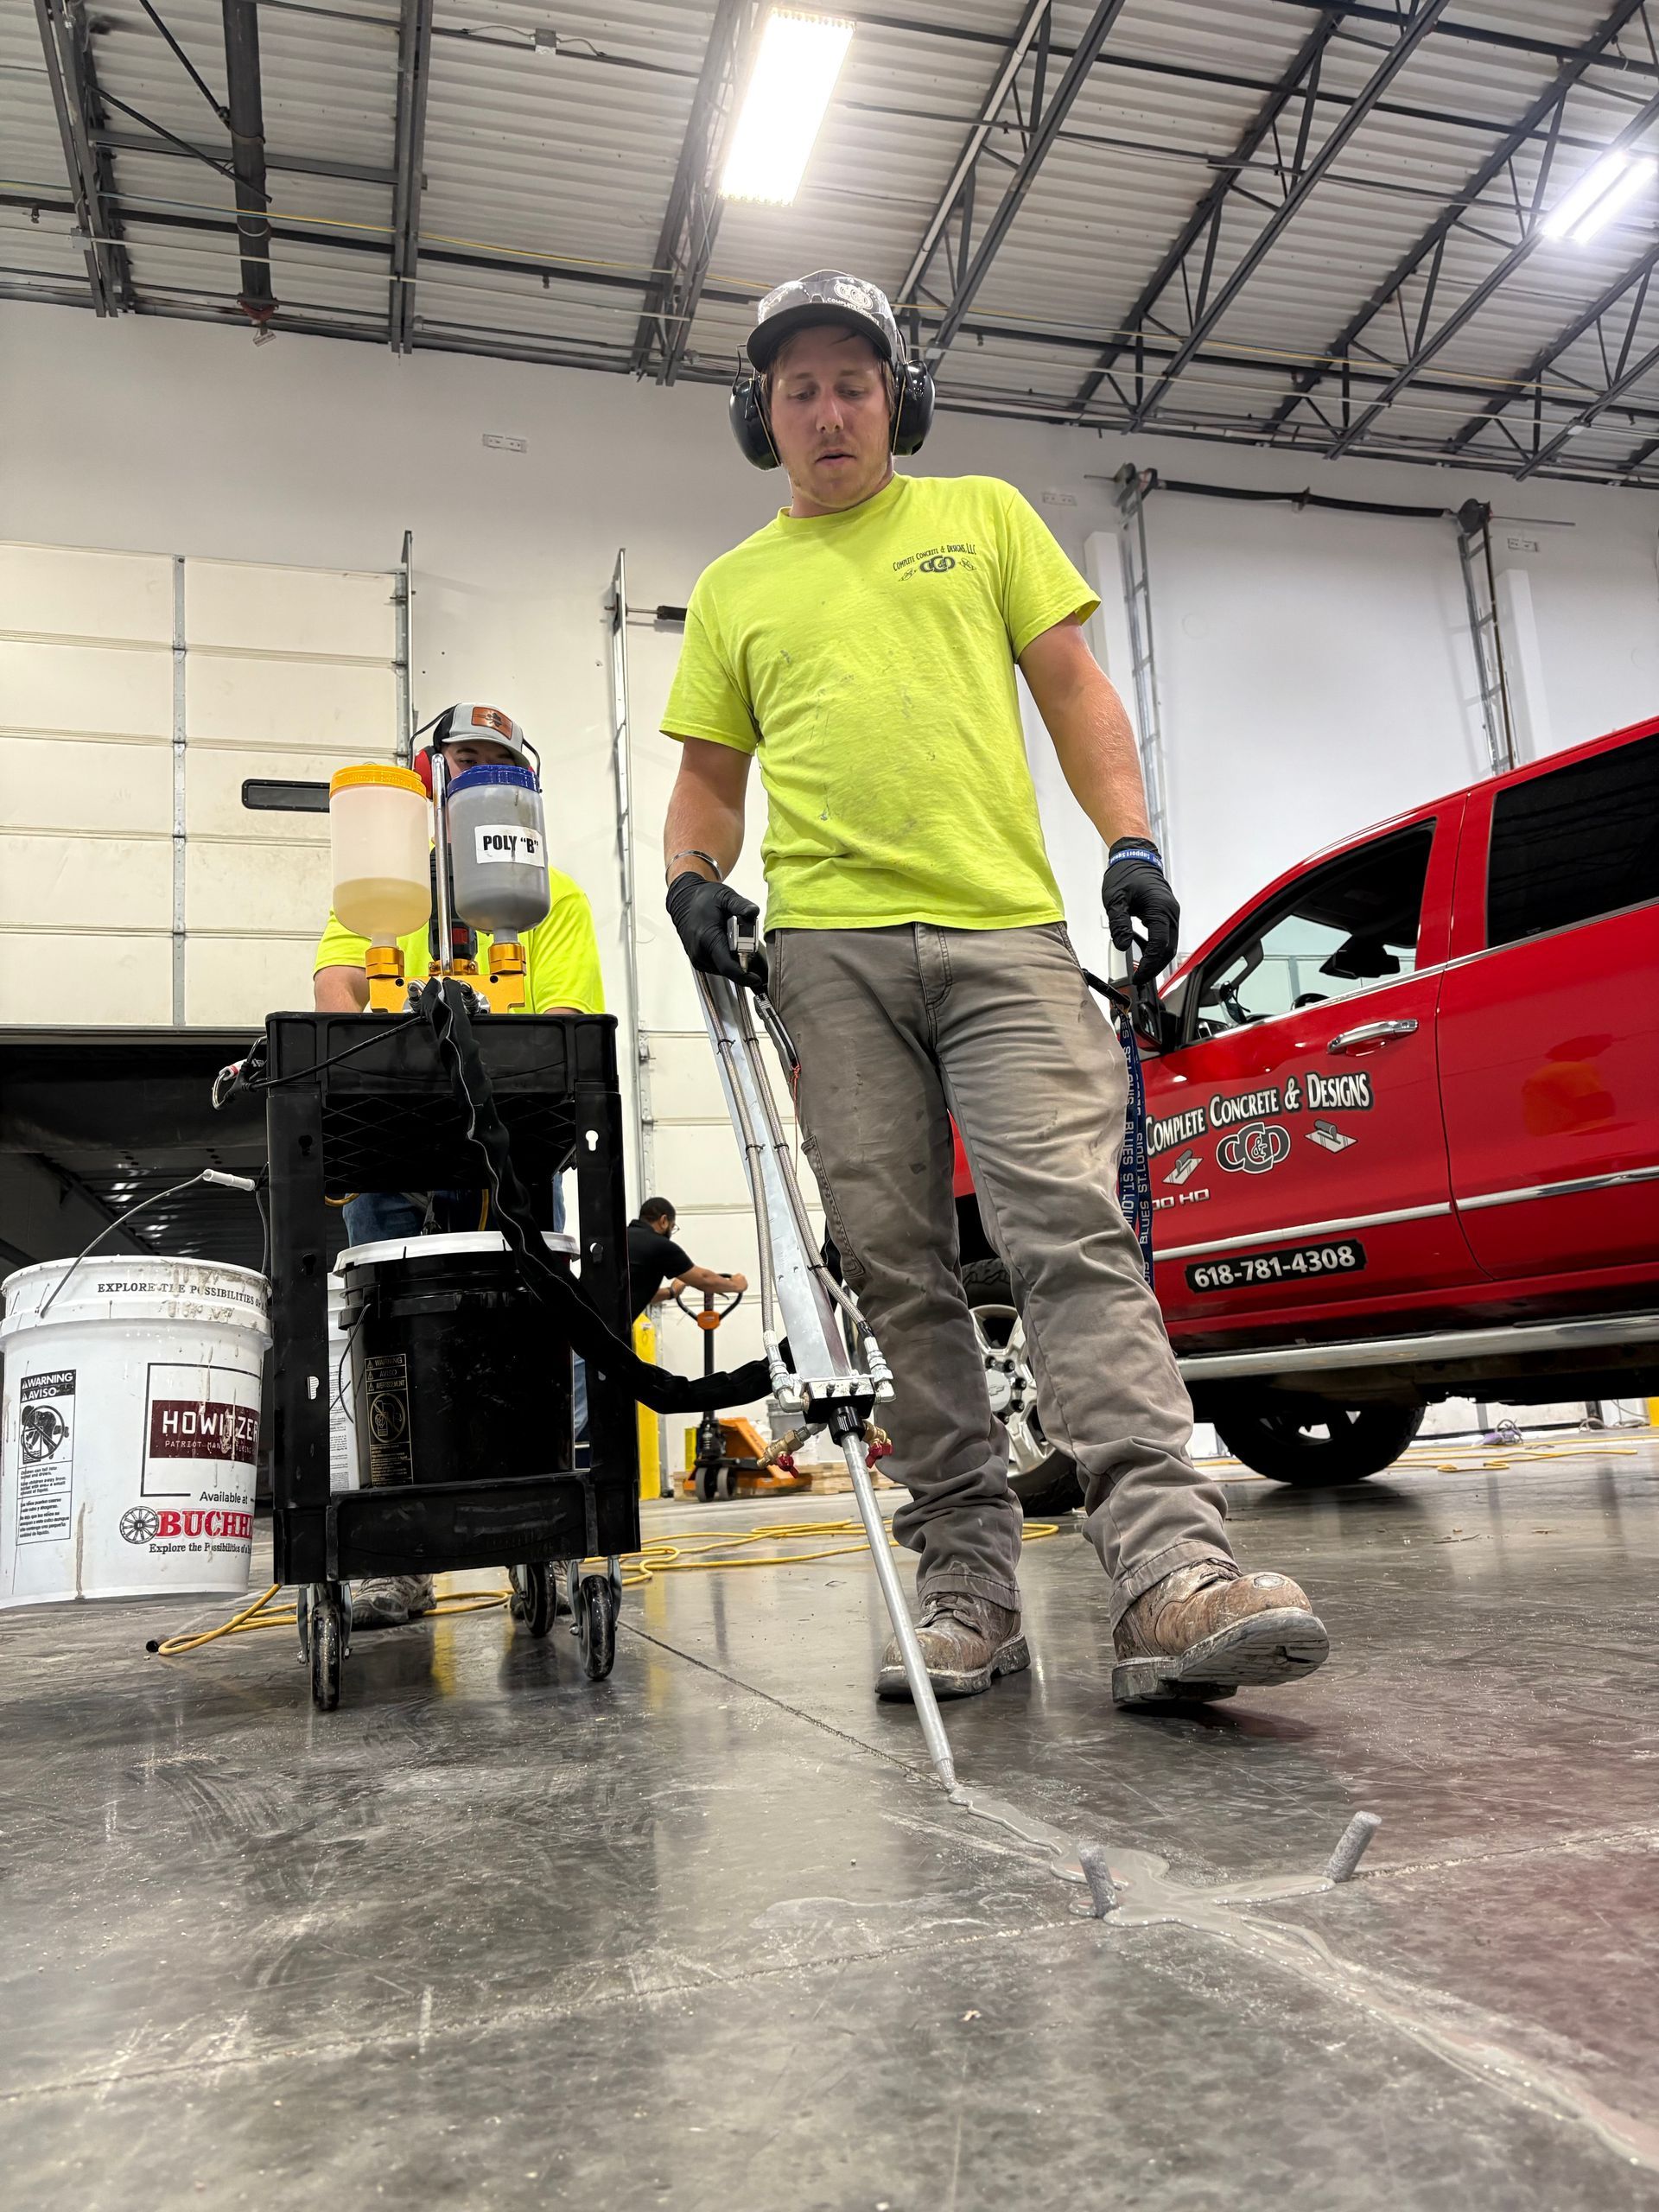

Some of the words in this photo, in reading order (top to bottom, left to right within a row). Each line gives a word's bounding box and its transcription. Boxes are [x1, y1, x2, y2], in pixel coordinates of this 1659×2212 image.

[893, 556, 916, 571] COMPLETE
[915, 548, 939, 561] CONCRETE
[483, 835, 518, 851] POLY
[1146, 1108, 1206, 1156] COMPLETE
[1210, 1088, 1280, 1128] CONCRETE
[1284, 1077, 1300, 1110] &
[1306, 1073, 1370, 1109] DESIGNS
[1122, 1121, 1135, 1166] BLUES
[1179, 1188, 1211, 1205] HD
[1139, 1200, 1151, 1244] BLUES
[1194, 1246, 1357, 1288] 618-781-4308
[98, 1282, 156, 1293] EXPLORE
[28, 1372, 73, 1388] WARNING
[29, 1387, 57, 1401] AVISO
[162, 1410, 259, 1443] HOWITZER
[164, 1439, 202, 1449] PATRIOT
[200, 1491, 242, 1504] Available
[242, 1495, 248, 1505] at
[149, 1542, 186, 1554] Explore
[188, 1541, 202, 1553] the
